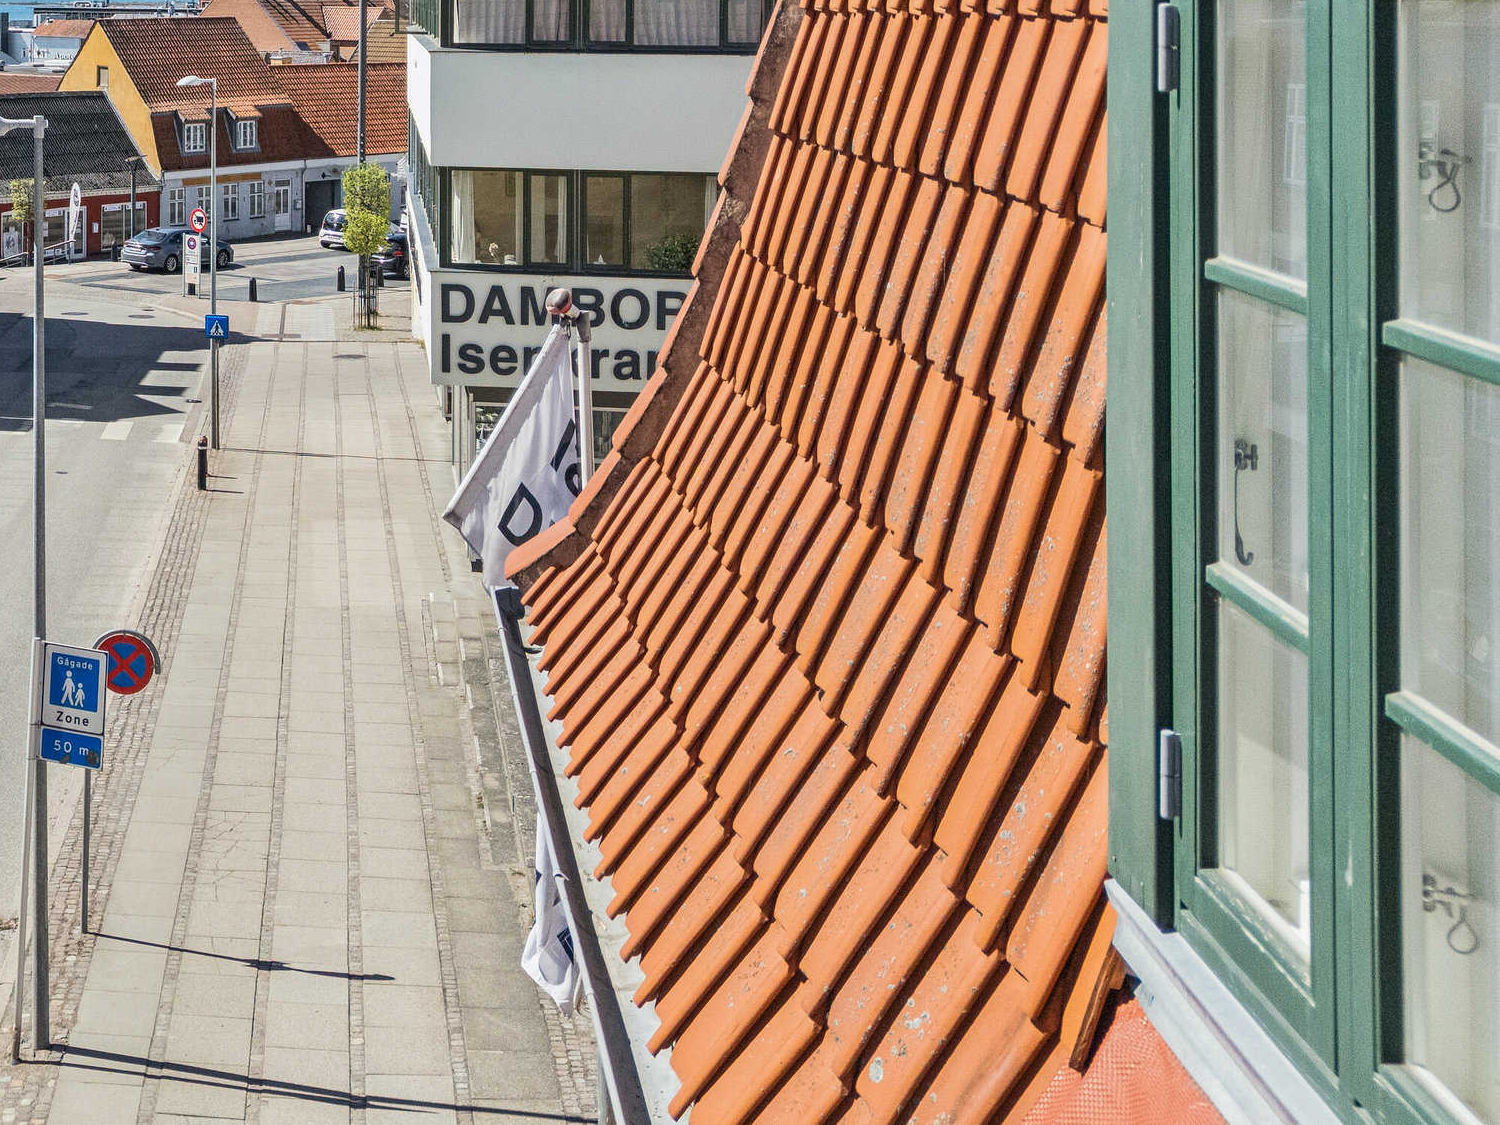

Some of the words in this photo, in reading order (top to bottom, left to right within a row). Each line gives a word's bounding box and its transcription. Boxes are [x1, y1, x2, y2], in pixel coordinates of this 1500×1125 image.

[57, 656, 93, 671] Gågade
[56, 711, 89, 727] Zone
[54, 739, 72, 753] 50
[79, 746, 90, 756] m
